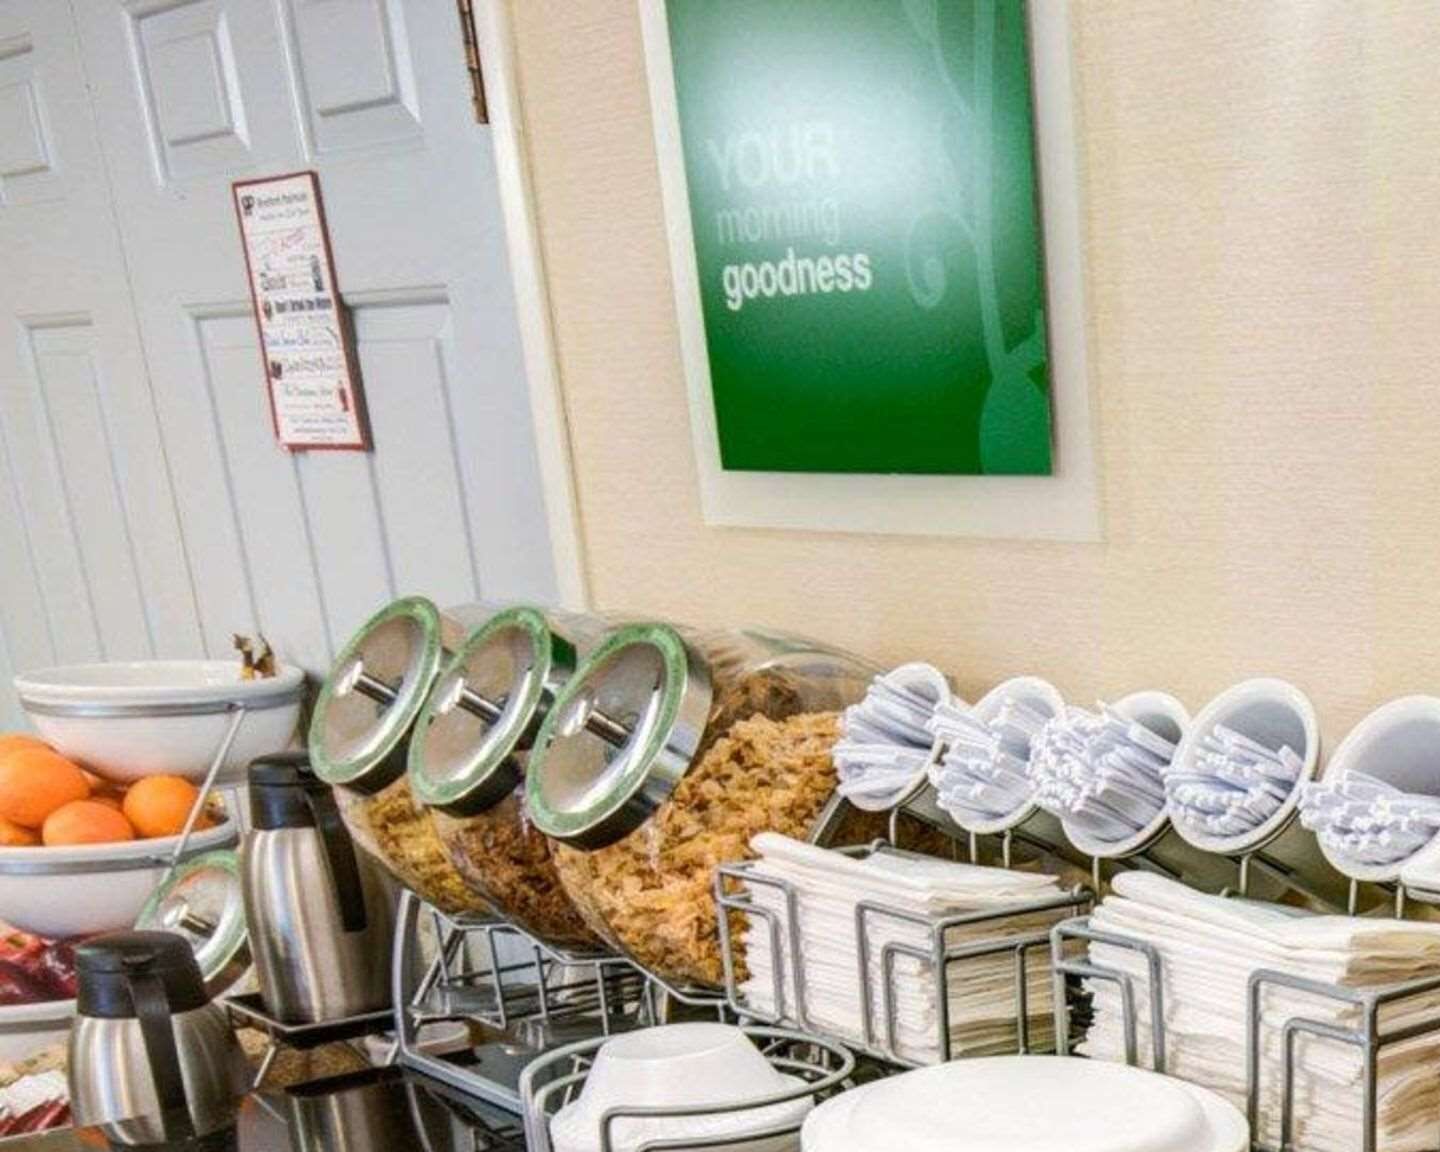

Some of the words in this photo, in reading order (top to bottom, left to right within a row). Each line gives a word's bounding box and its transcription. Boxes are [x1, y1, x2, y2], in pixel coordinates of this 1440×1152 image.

[705, 122, 840, 190] YOUR
[716, 197, 841, 246] morning
[723, 247, 873, 312] goodness
